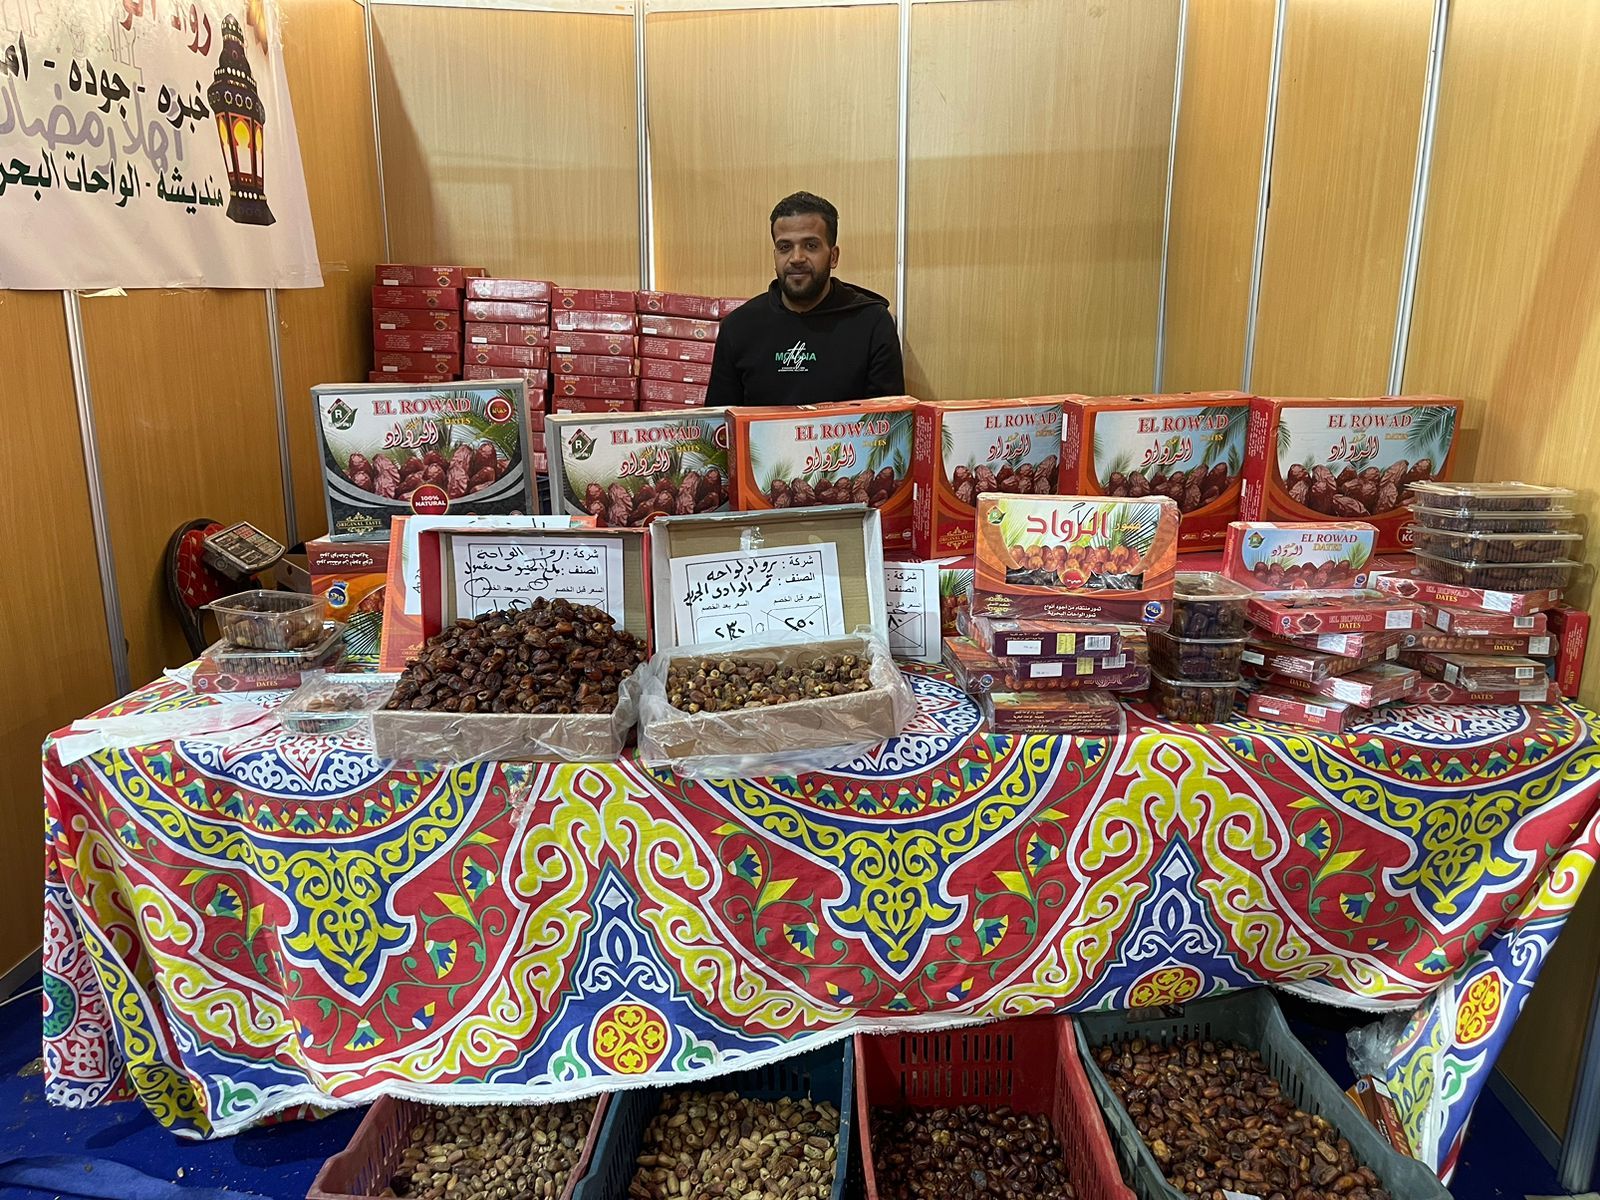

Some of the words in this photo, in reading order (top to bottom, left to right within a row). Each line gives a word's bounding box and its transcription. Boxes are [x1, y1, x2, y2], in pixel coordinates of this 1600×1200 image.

[64, 150, 141, 208] الواحات
[372, 400, 397, 416] EL
[400, 398, 471, 415] ROWAD
[334, 409, 343, 418] R
[985, 415, 1003, 430] EL
[1005, 412, 1058, 427] ROWAD
[1137, 417, 1161, 433] EL
[1163, 414, 1230, 432] ROWAD
[1327, 414, 1347, 428] EL
[1350, 413, 1412, 428] ROWAD
[610, 429, 634, 446] EL
[635, 425, 701, 443] ROWAD
[795, 425, 818, 441] EL
[821, 419, 891, 440] ROWAD
[575, 440, 582, 449] R
[1026, 507, 1110, 543] الرواد
[1301, 534, 1314, 542] EL
[1316, 533, 1358, 543] ROWAD
[573, 548, 599, 560] شركة
[789, 555, 814, 567] شركة
[568, 566, 599, 575] الصنف
[894, 571, 917, 582] شركة
[785, 572, 816, 584] الصنف
[888, 584, 917, 593] الصنف
[1435, 593, 1458, 602] DATES
